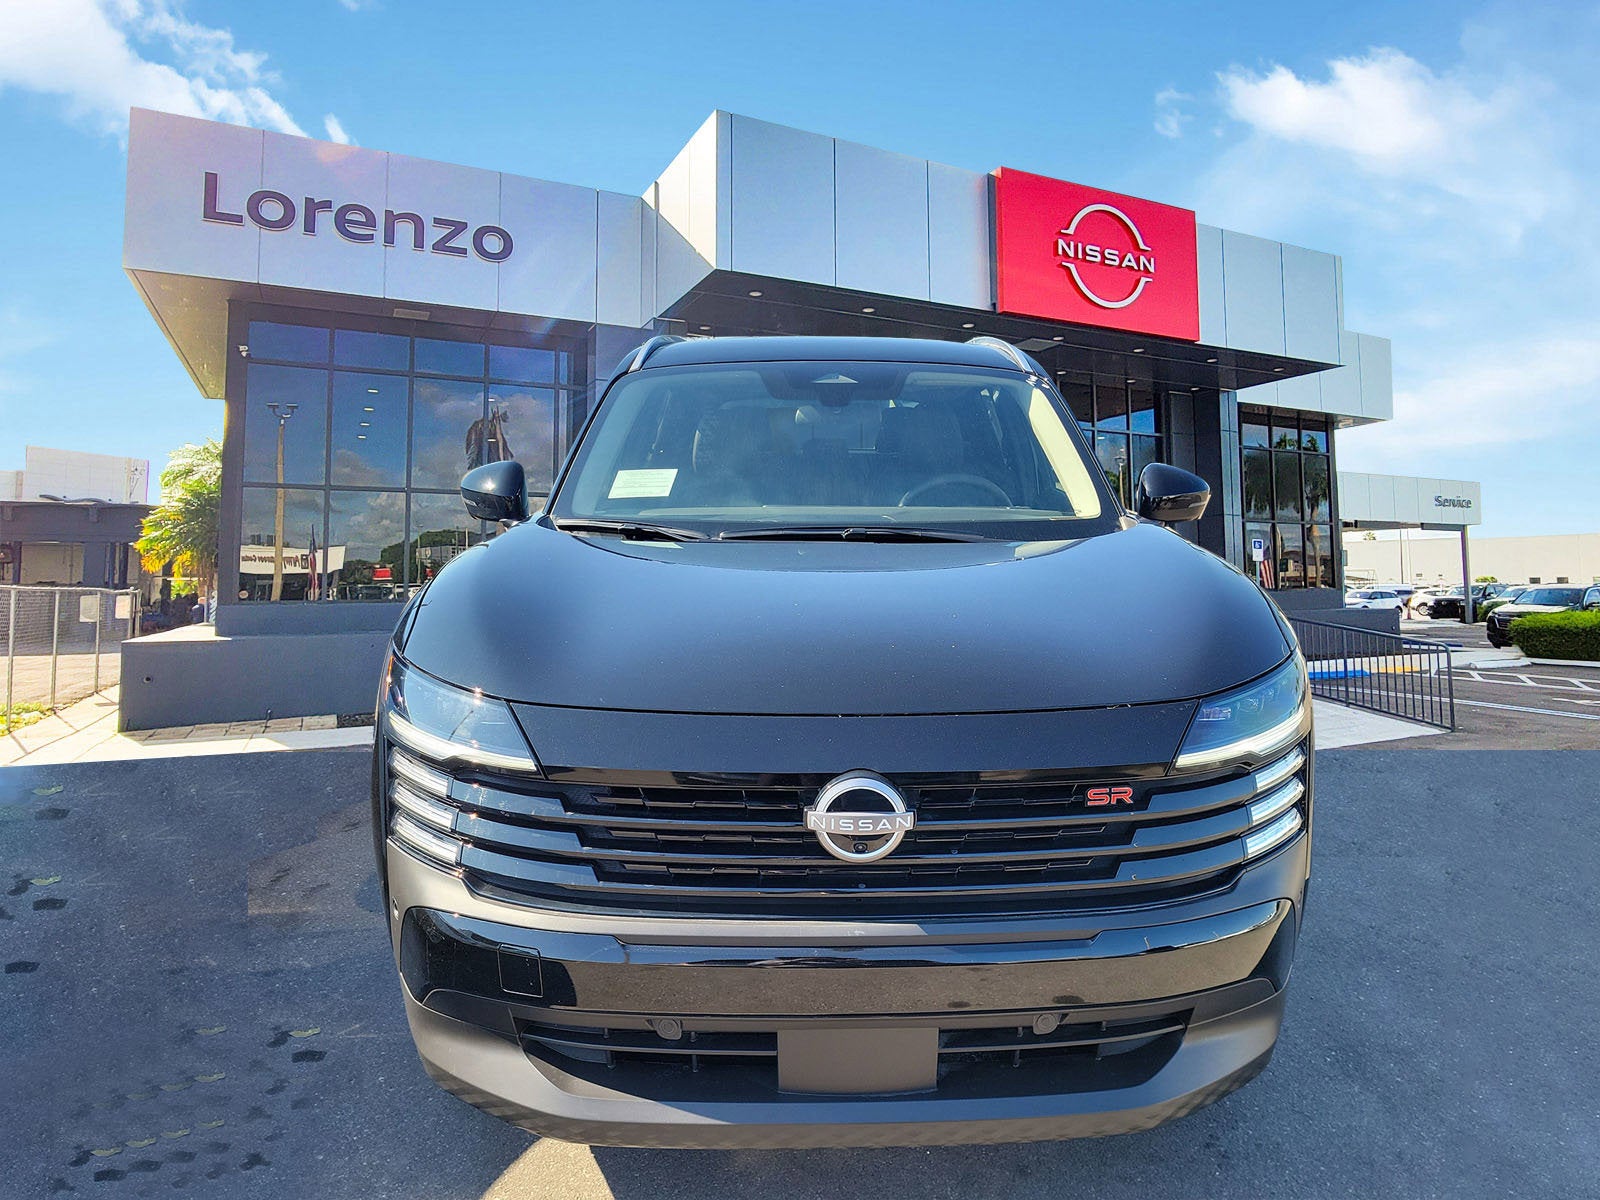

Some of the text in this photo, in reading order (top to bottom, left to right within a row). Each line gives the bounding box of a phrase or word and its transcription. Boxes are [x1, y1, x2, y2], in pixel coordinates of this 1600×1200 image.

[202, 171, 514, 262] Lorenzo
[1057, 238, 1155, 273] NISSAN
[1434, 495, 1472, 508] Service
[1087, 787, 1133, 806] SR
[810, 816, 911, 831] NISSAN
